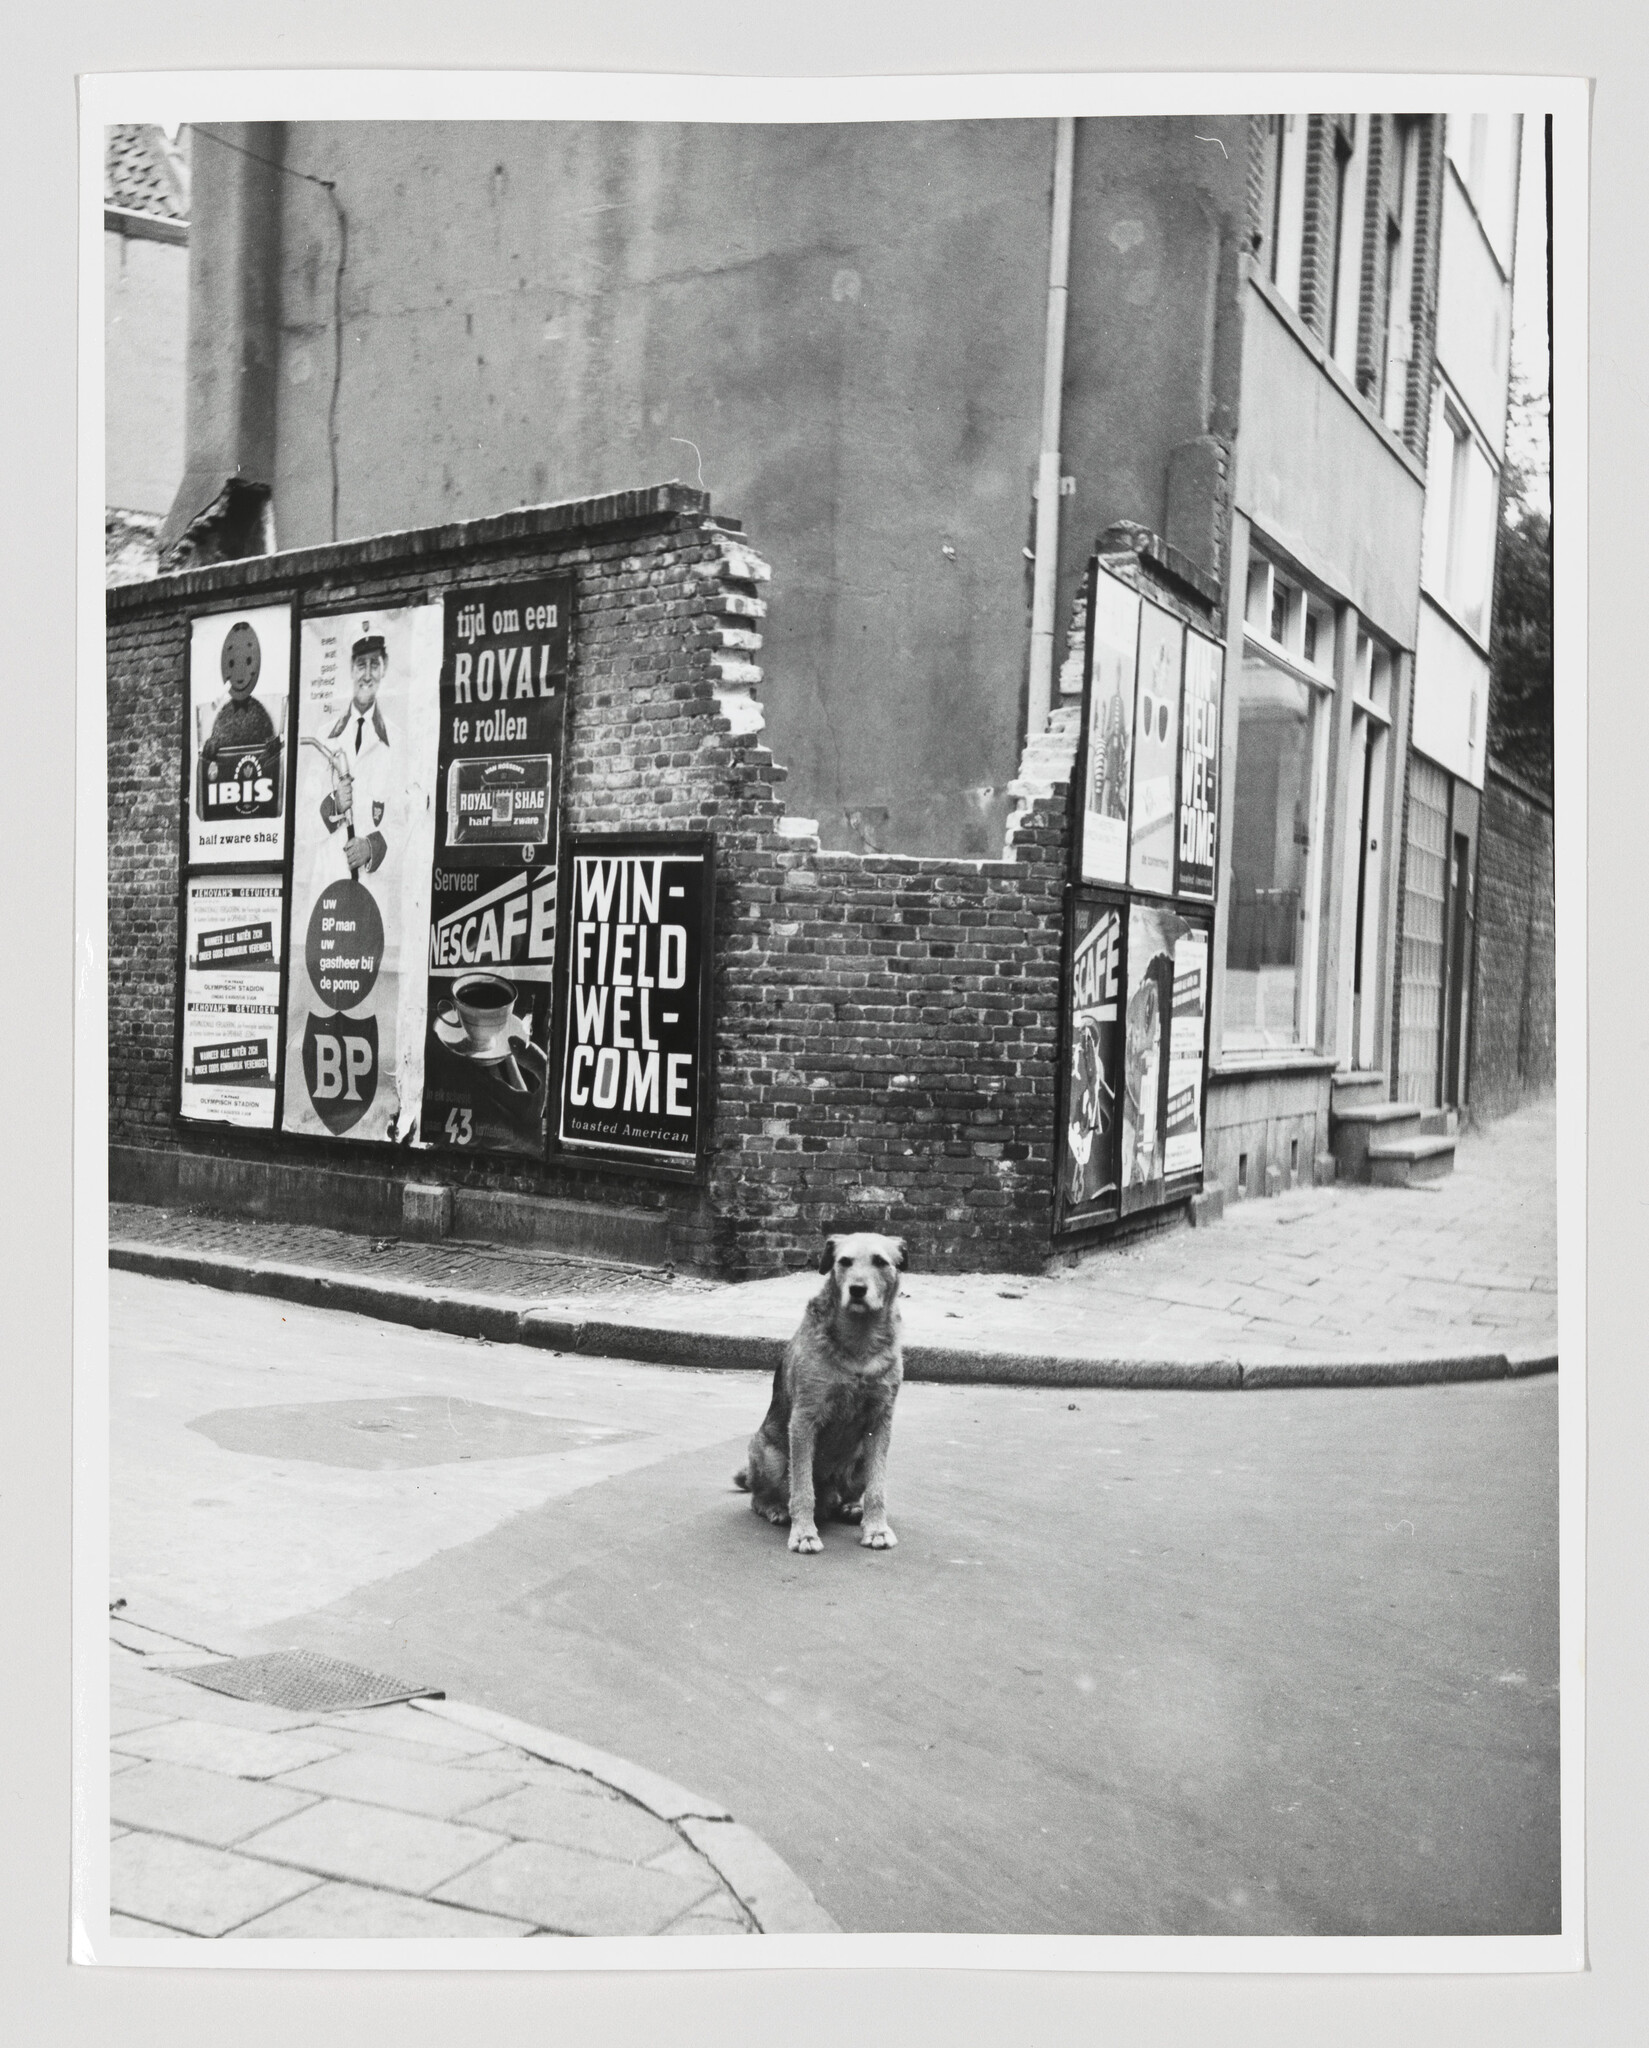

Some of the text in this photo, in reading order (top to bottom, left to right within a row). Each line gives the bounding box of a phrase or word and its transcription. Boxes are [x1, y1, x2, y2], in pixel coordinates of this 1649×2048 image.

[457, 603, 558, 645] tijd om een
[454, 645, 556, 704] ROYAL
[1185, 631, 1217, 702] WIN-
[453, 709, 528, 744] te rollen
[1182, 691, 1216, 760] FIELD
[208, 777, 274, 806] IBIS
[1181, 749, 1213, 811] WEL-
[460, 793, 493, 811] ROYAL
[514, 790, 545, 809] SHAG
[468, 816, 540, 826] half zware
[1179, 804, 1215, 867] COME
[199, 830, 278, 846] half zware shag
[194, 888, 280, 898] JEHOVAH'S GETUIGEN
[434, 867, 480, 892] Serveer
[580, 859, 685, 923] WIN-
[322, 898, 337, 910] uw
[322, 917, 356, 932] BP man
[320, 939, 335, 950] uw
[577, 921, 687, 989] FIELD
[319, 955, 374, 972] gastheer bij
[319, 977, 360, 993] de pomp
[190, 1003, 276, 1014] JEHOVAH'S GETUIGEN
[575, 984, 679, 1050] WEL-
[312, 1033, 373, 1101] BP
[570, 1045, 692, 1117] COME
[199, 1098, 260, 1108] OLYMPISCH STADION
[444, 1108, 473, 1145] 43
[571, 1117, 690, 1143] toasted American
